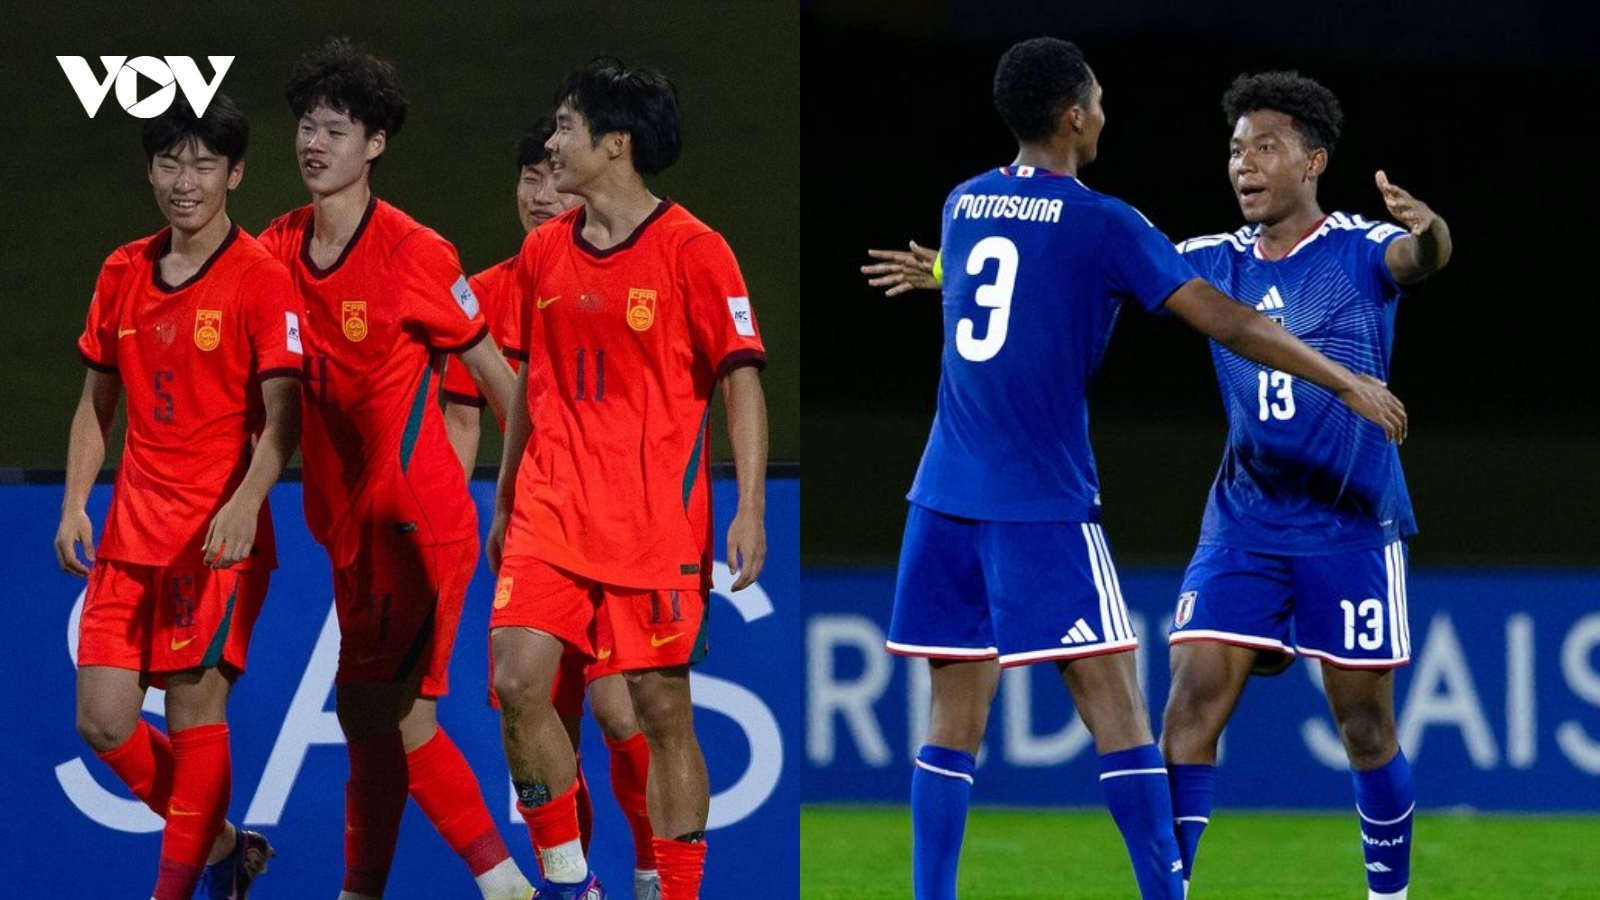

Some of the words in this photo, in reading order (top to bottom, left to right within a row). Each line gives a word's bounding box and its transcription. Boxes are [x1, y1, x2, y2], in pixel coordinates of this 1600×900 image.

[953, 194, 1064, 223] MOTOSUNA
[955, 235, 1019, 363] 3
[154, 369, 175, 423] 5
[574, 348, 605, 401] 11
[1258, 370, 1296, 421] 13
[172, 576, 195, 629] 5
[650, 589, 684, 625] 11
[1340, 598, 1383, 651] 13
